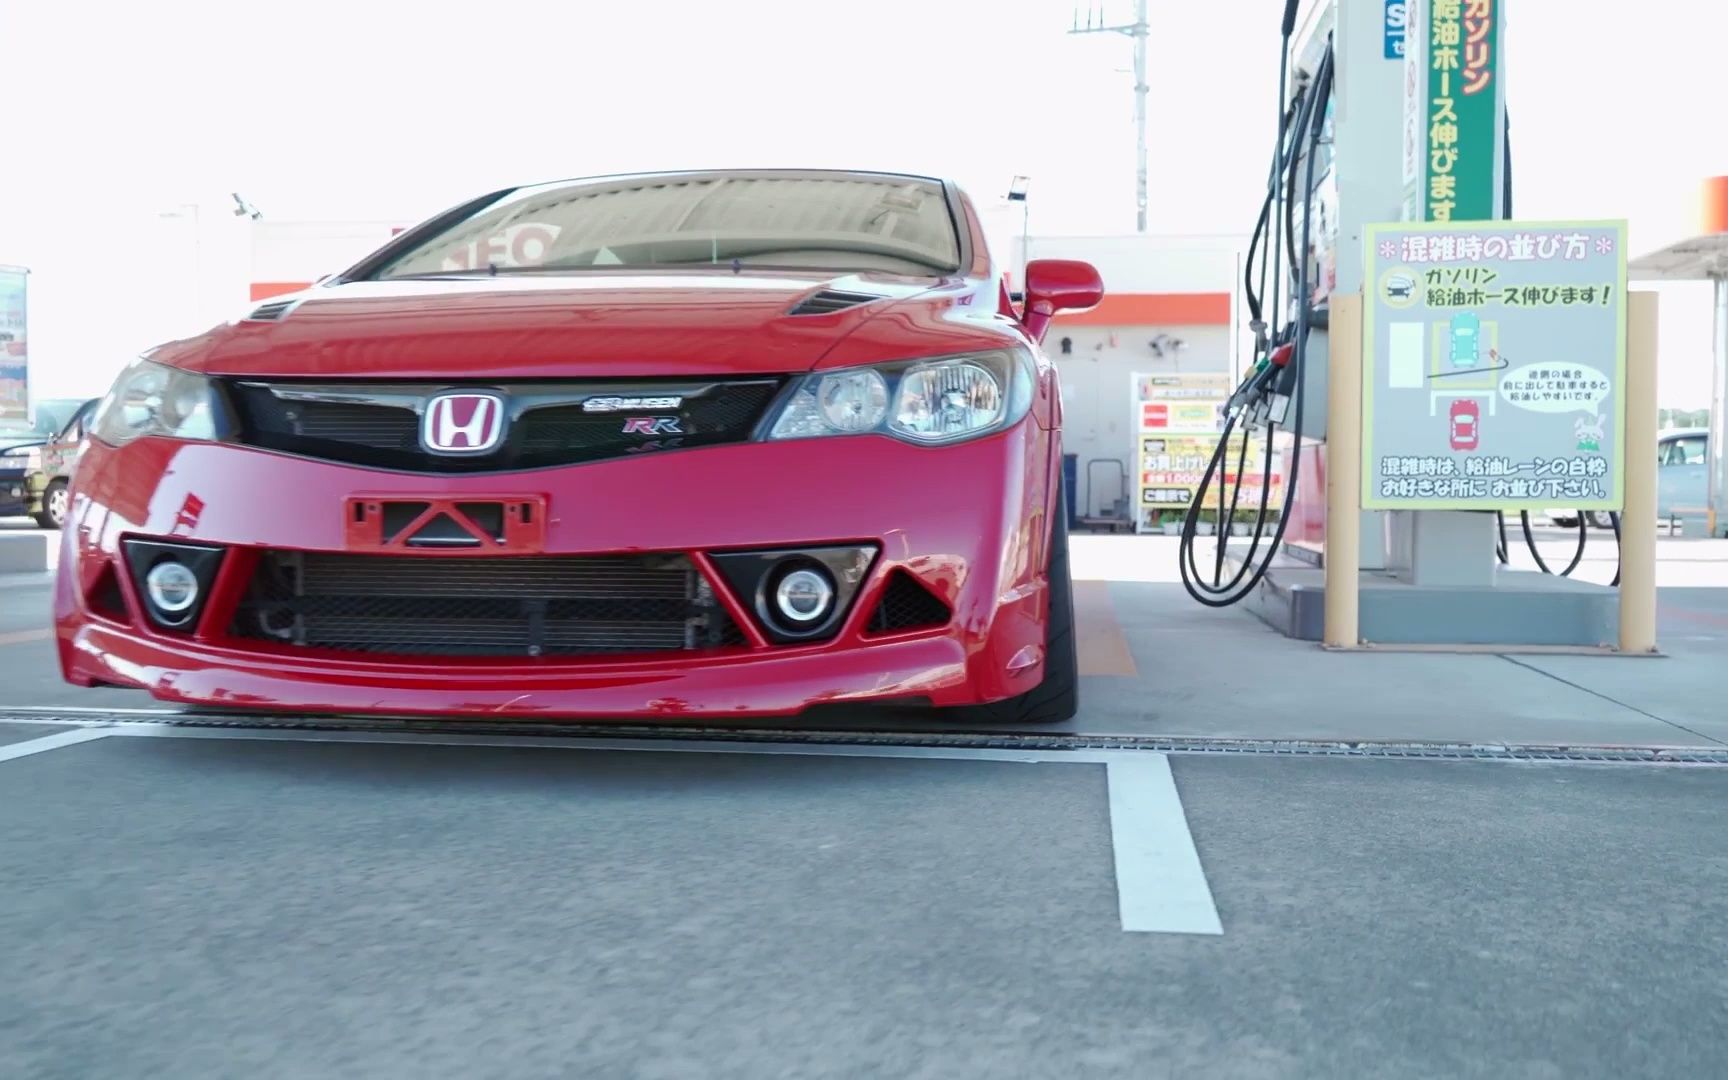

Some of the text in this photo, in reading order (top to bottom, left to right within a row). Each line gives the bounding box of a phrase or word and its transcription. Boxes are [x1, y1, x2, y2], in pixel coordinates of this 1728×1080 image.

[1401, 233, 1590, 262] 混雑時の並び方
[1425, 268, 1497, 285] ガソリン
[1381, 456, 1607, 476] 混雑時は、給油レーンの白枠
[1381, 479, 1606, 498] お好きな所に お並び下さい。
